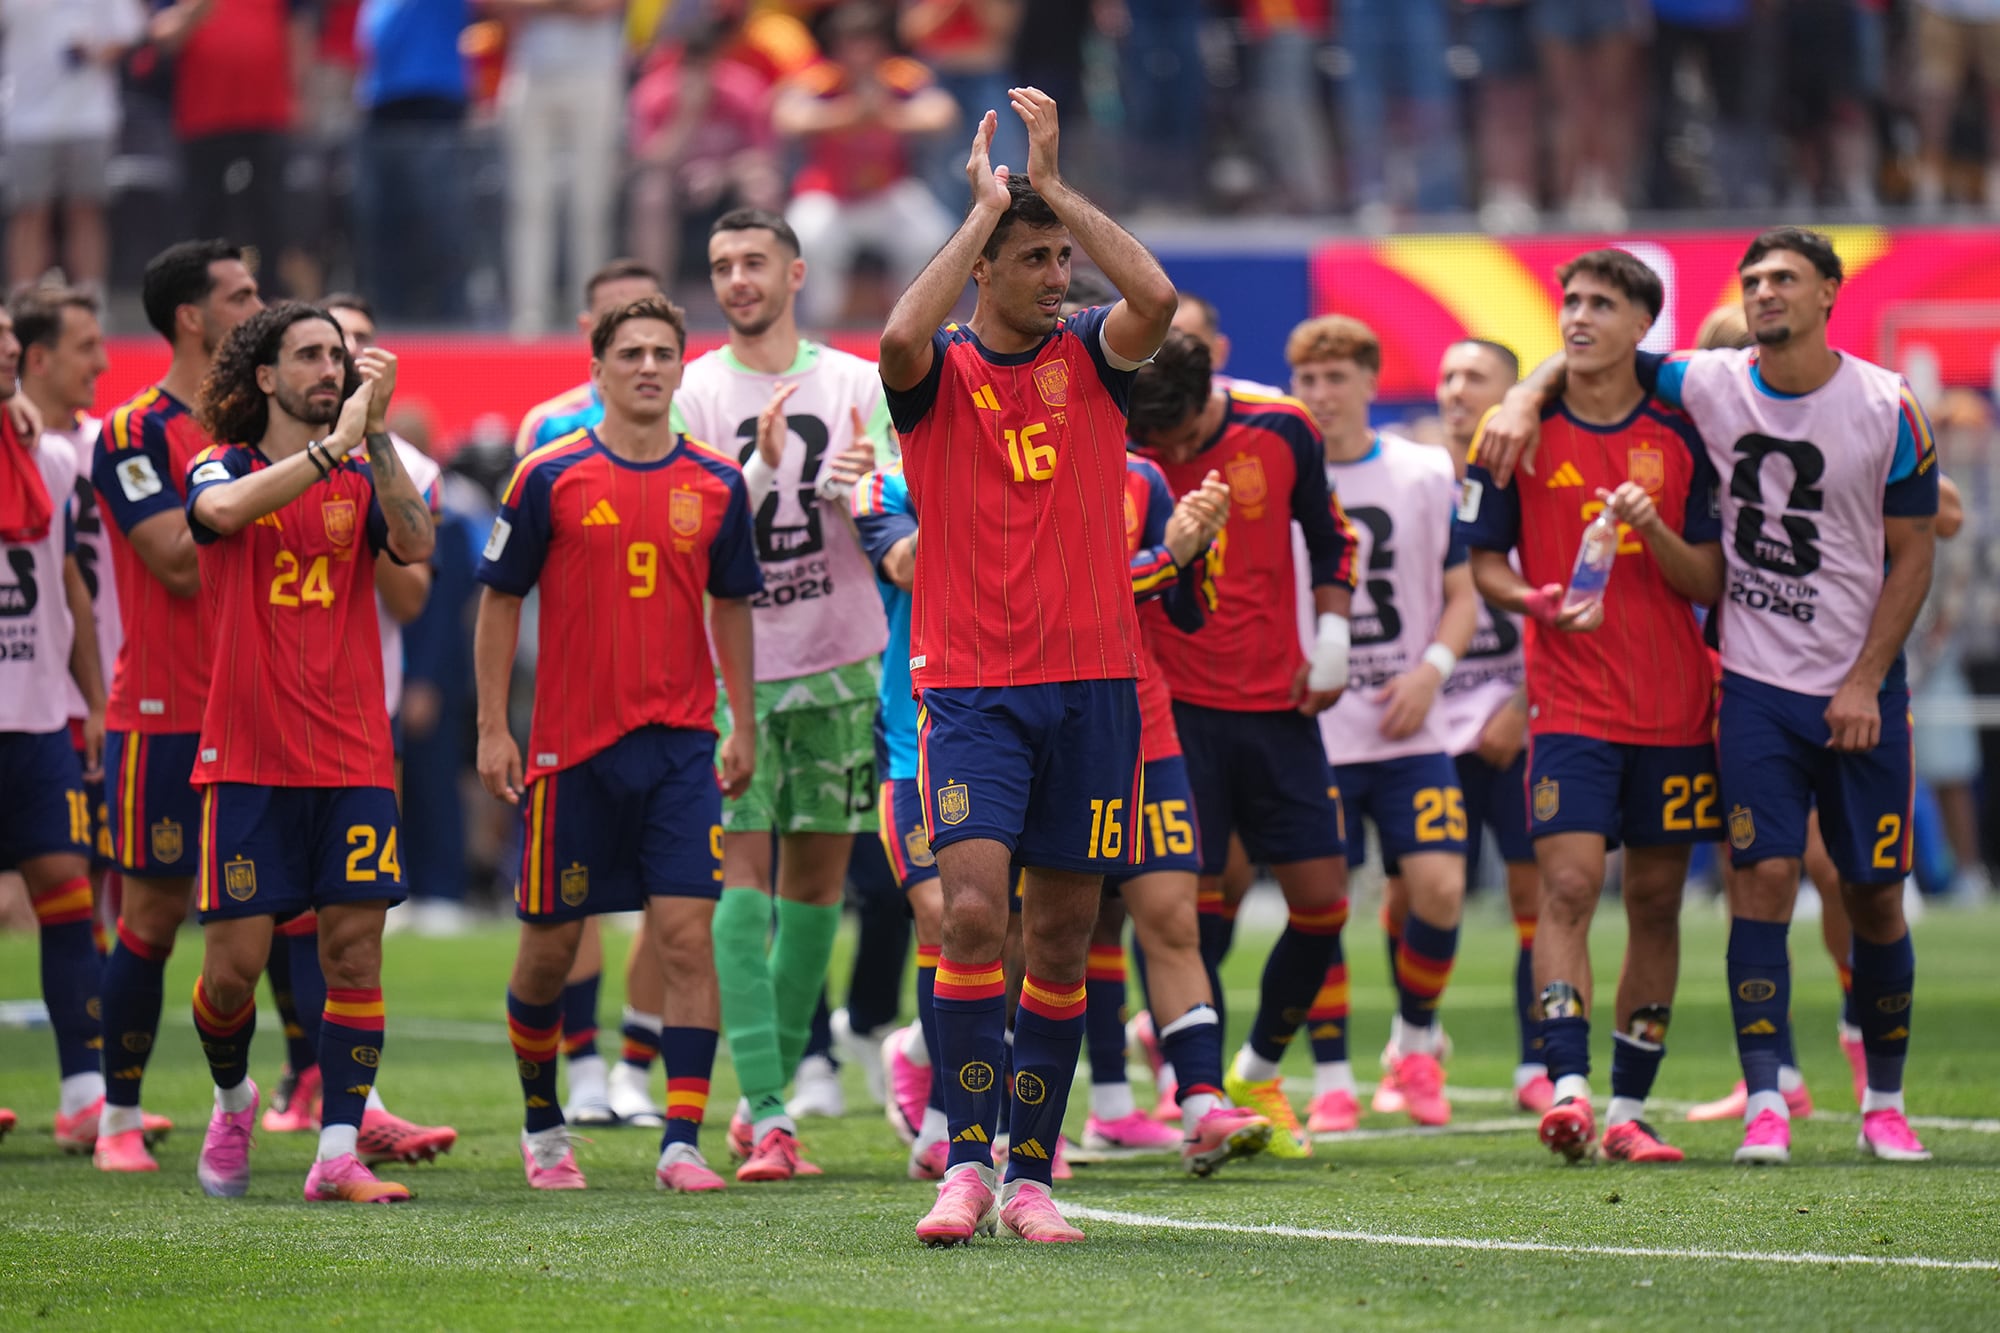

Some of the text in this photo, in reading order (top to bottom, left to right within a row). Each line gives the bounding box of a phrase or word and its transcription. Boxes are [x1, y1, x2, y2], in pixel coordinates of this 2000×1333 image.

[1004, 422, 1057, 482] 16
[270, 551, 335, 608] 24
[627, 542, 657, 598] 9
[1754, 541, 1797, 566] FIFA
[751, 576, 834, 607] 2026
[1730, 583, 1816, 623] 2026
[845, 762, 876, 817] 13
[1413, 787, 1468, 842] 25
[1662, 774, 1722, 831] 22
[345, 824, 402, 883] 24
[1087, 798, 1123, 859] 16
[1143, 800, 1195, 857] 15
[1872, 813, 1902, 869] 2
[967, 1068, 986, 1076] RF
[967, 1077, 986, 1086] EF
[1020, 1077, 1038, 1088] RF
[1020, 1087, 1038, 1097] EF
